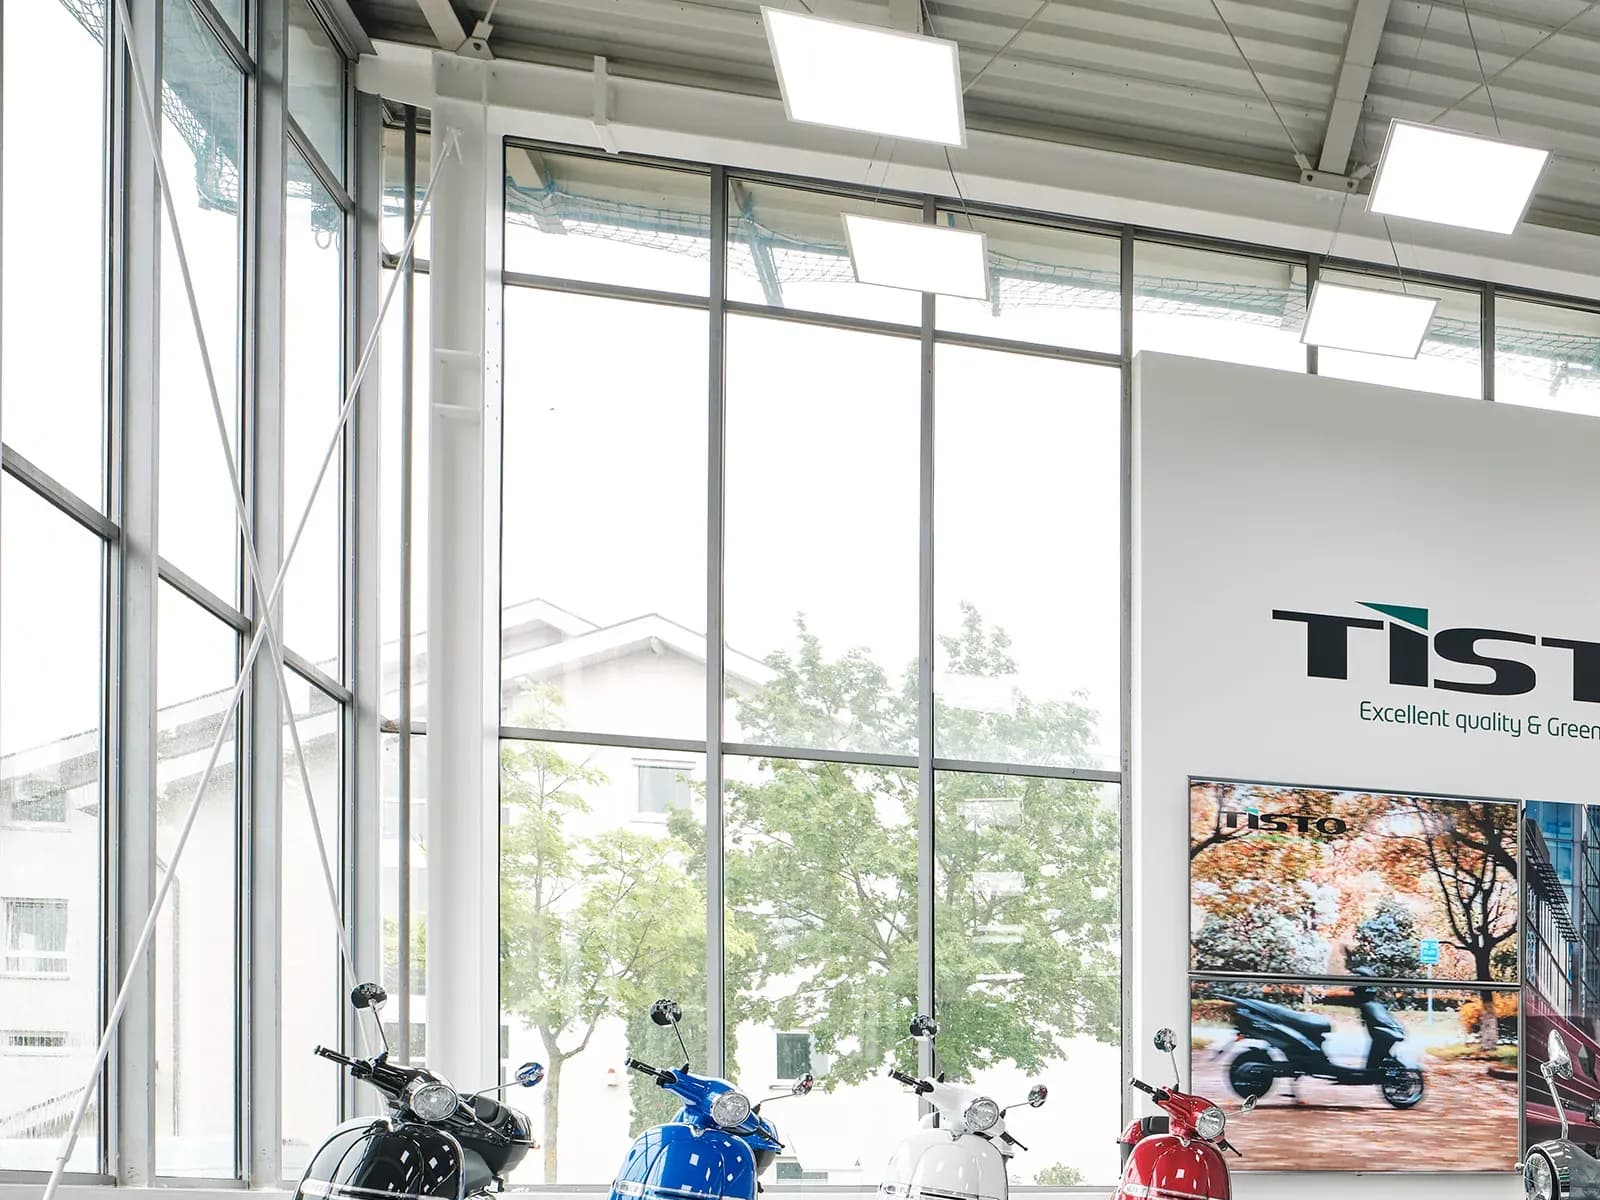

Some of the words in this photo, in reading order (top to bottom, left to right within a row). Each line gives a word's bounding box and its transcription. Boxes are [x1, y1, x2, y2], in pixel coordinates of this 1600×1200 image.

[1359, 701, 1450, 728] Excellent
[1455, 712, 1522, 738] quality
[1528, 716, 1542, 735] &
[1218, 807, 1347, 835] TISTO
